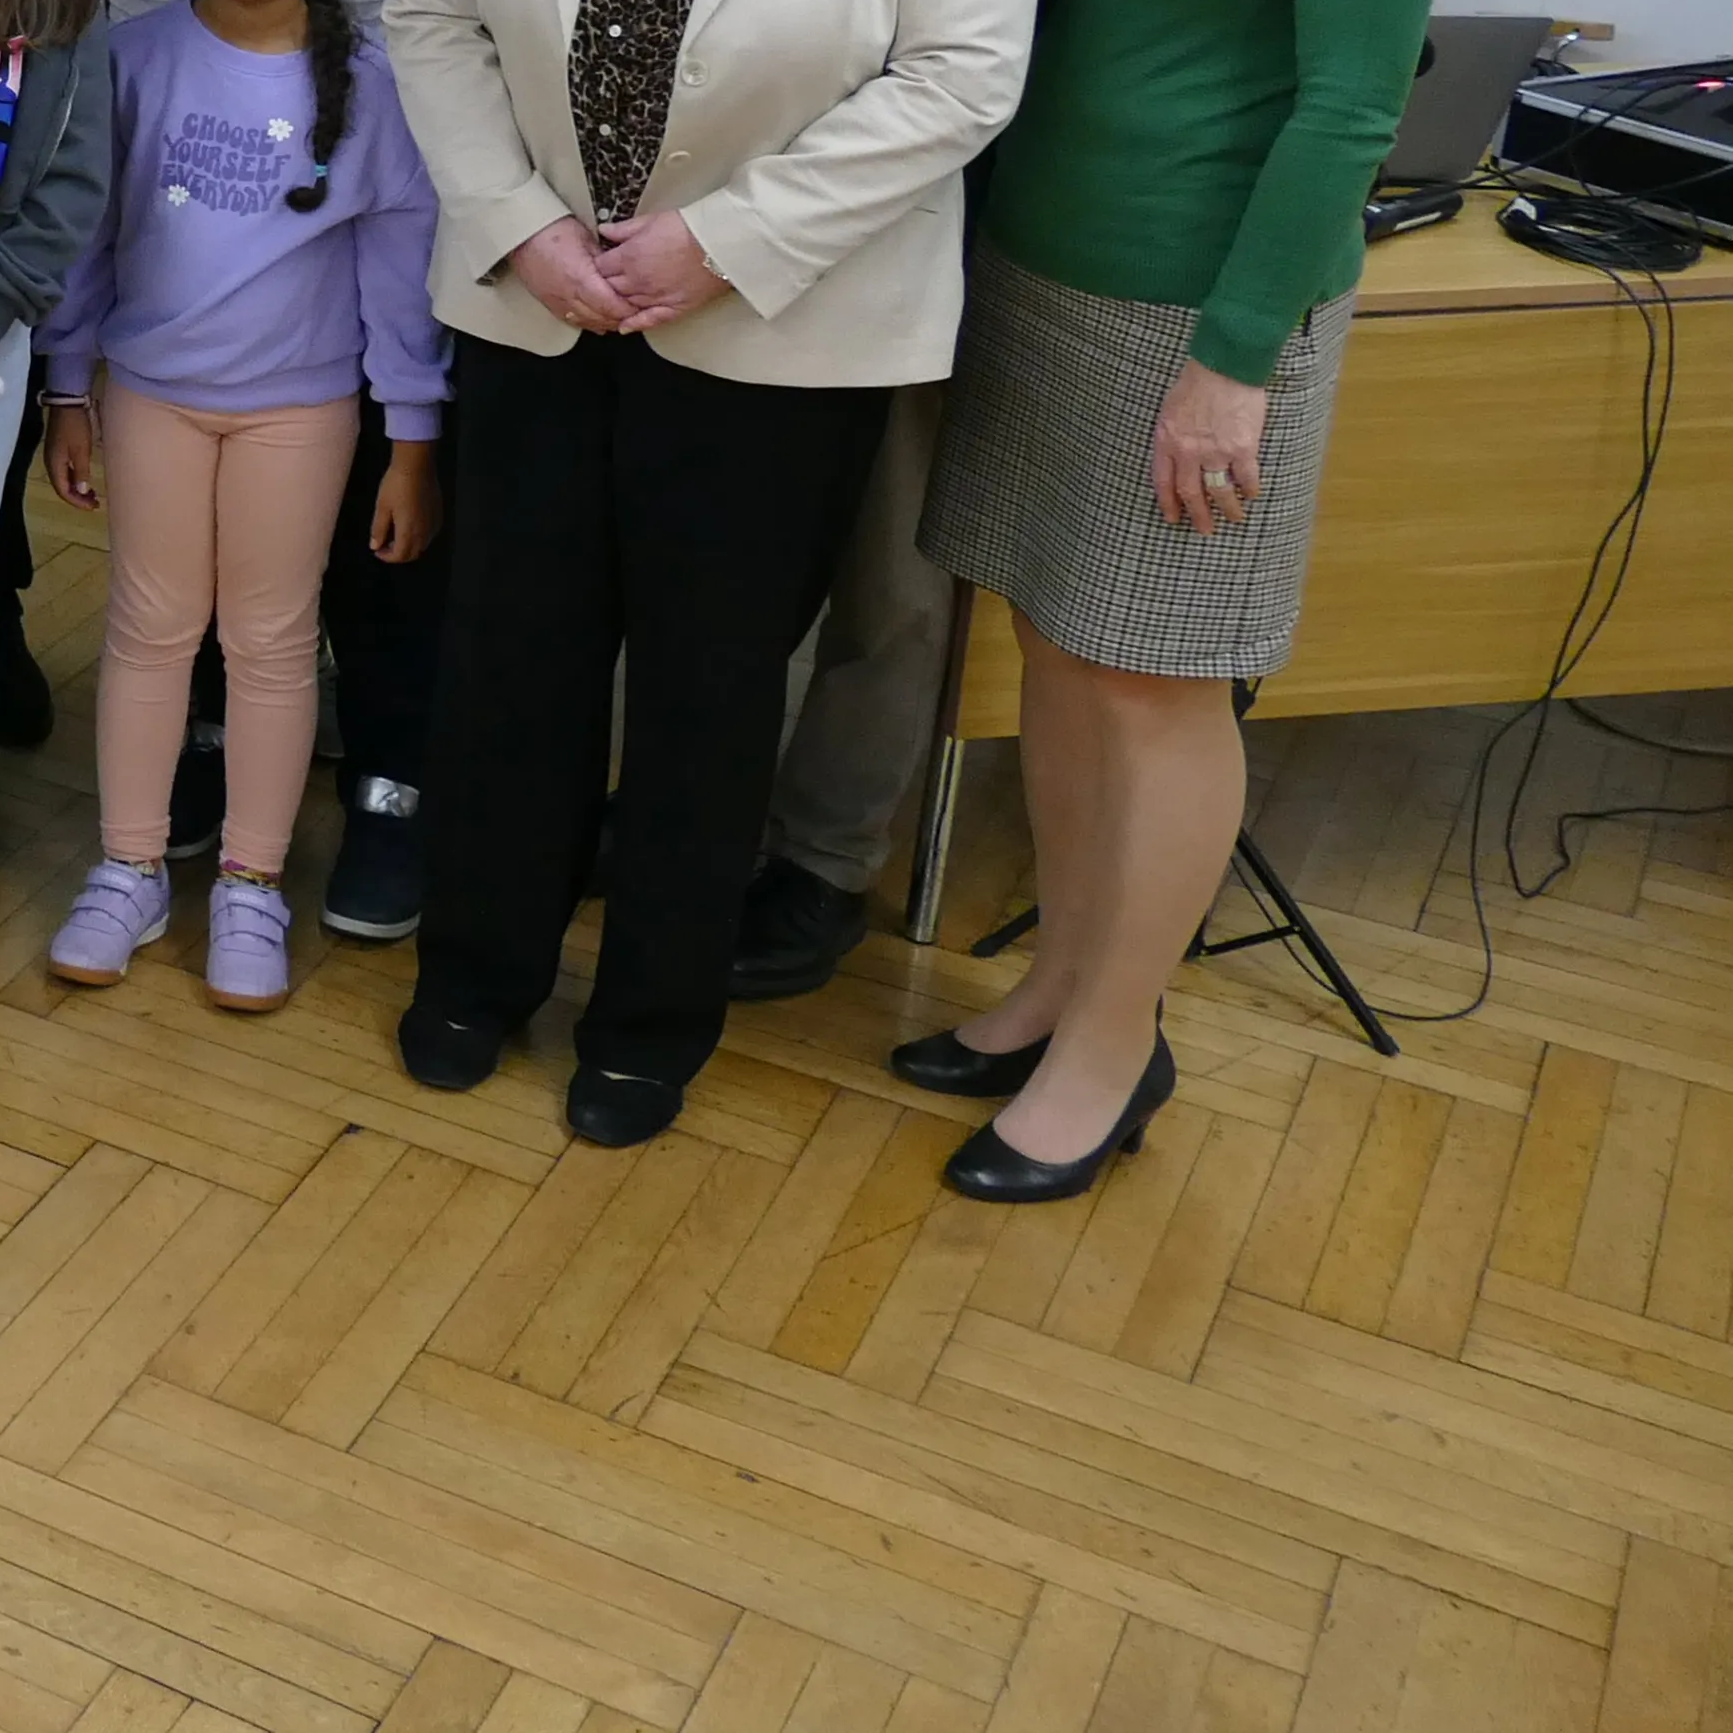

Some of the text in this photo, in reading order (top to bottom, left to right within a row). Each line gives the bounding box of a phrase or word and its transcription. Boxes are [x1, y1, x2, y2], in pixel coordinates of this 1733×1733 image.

[164, 134, 290, 181] YOURSELF
[182, 113, 276, 155] CHOOSE
[161, 164, 280, 216] EVERYDAY
